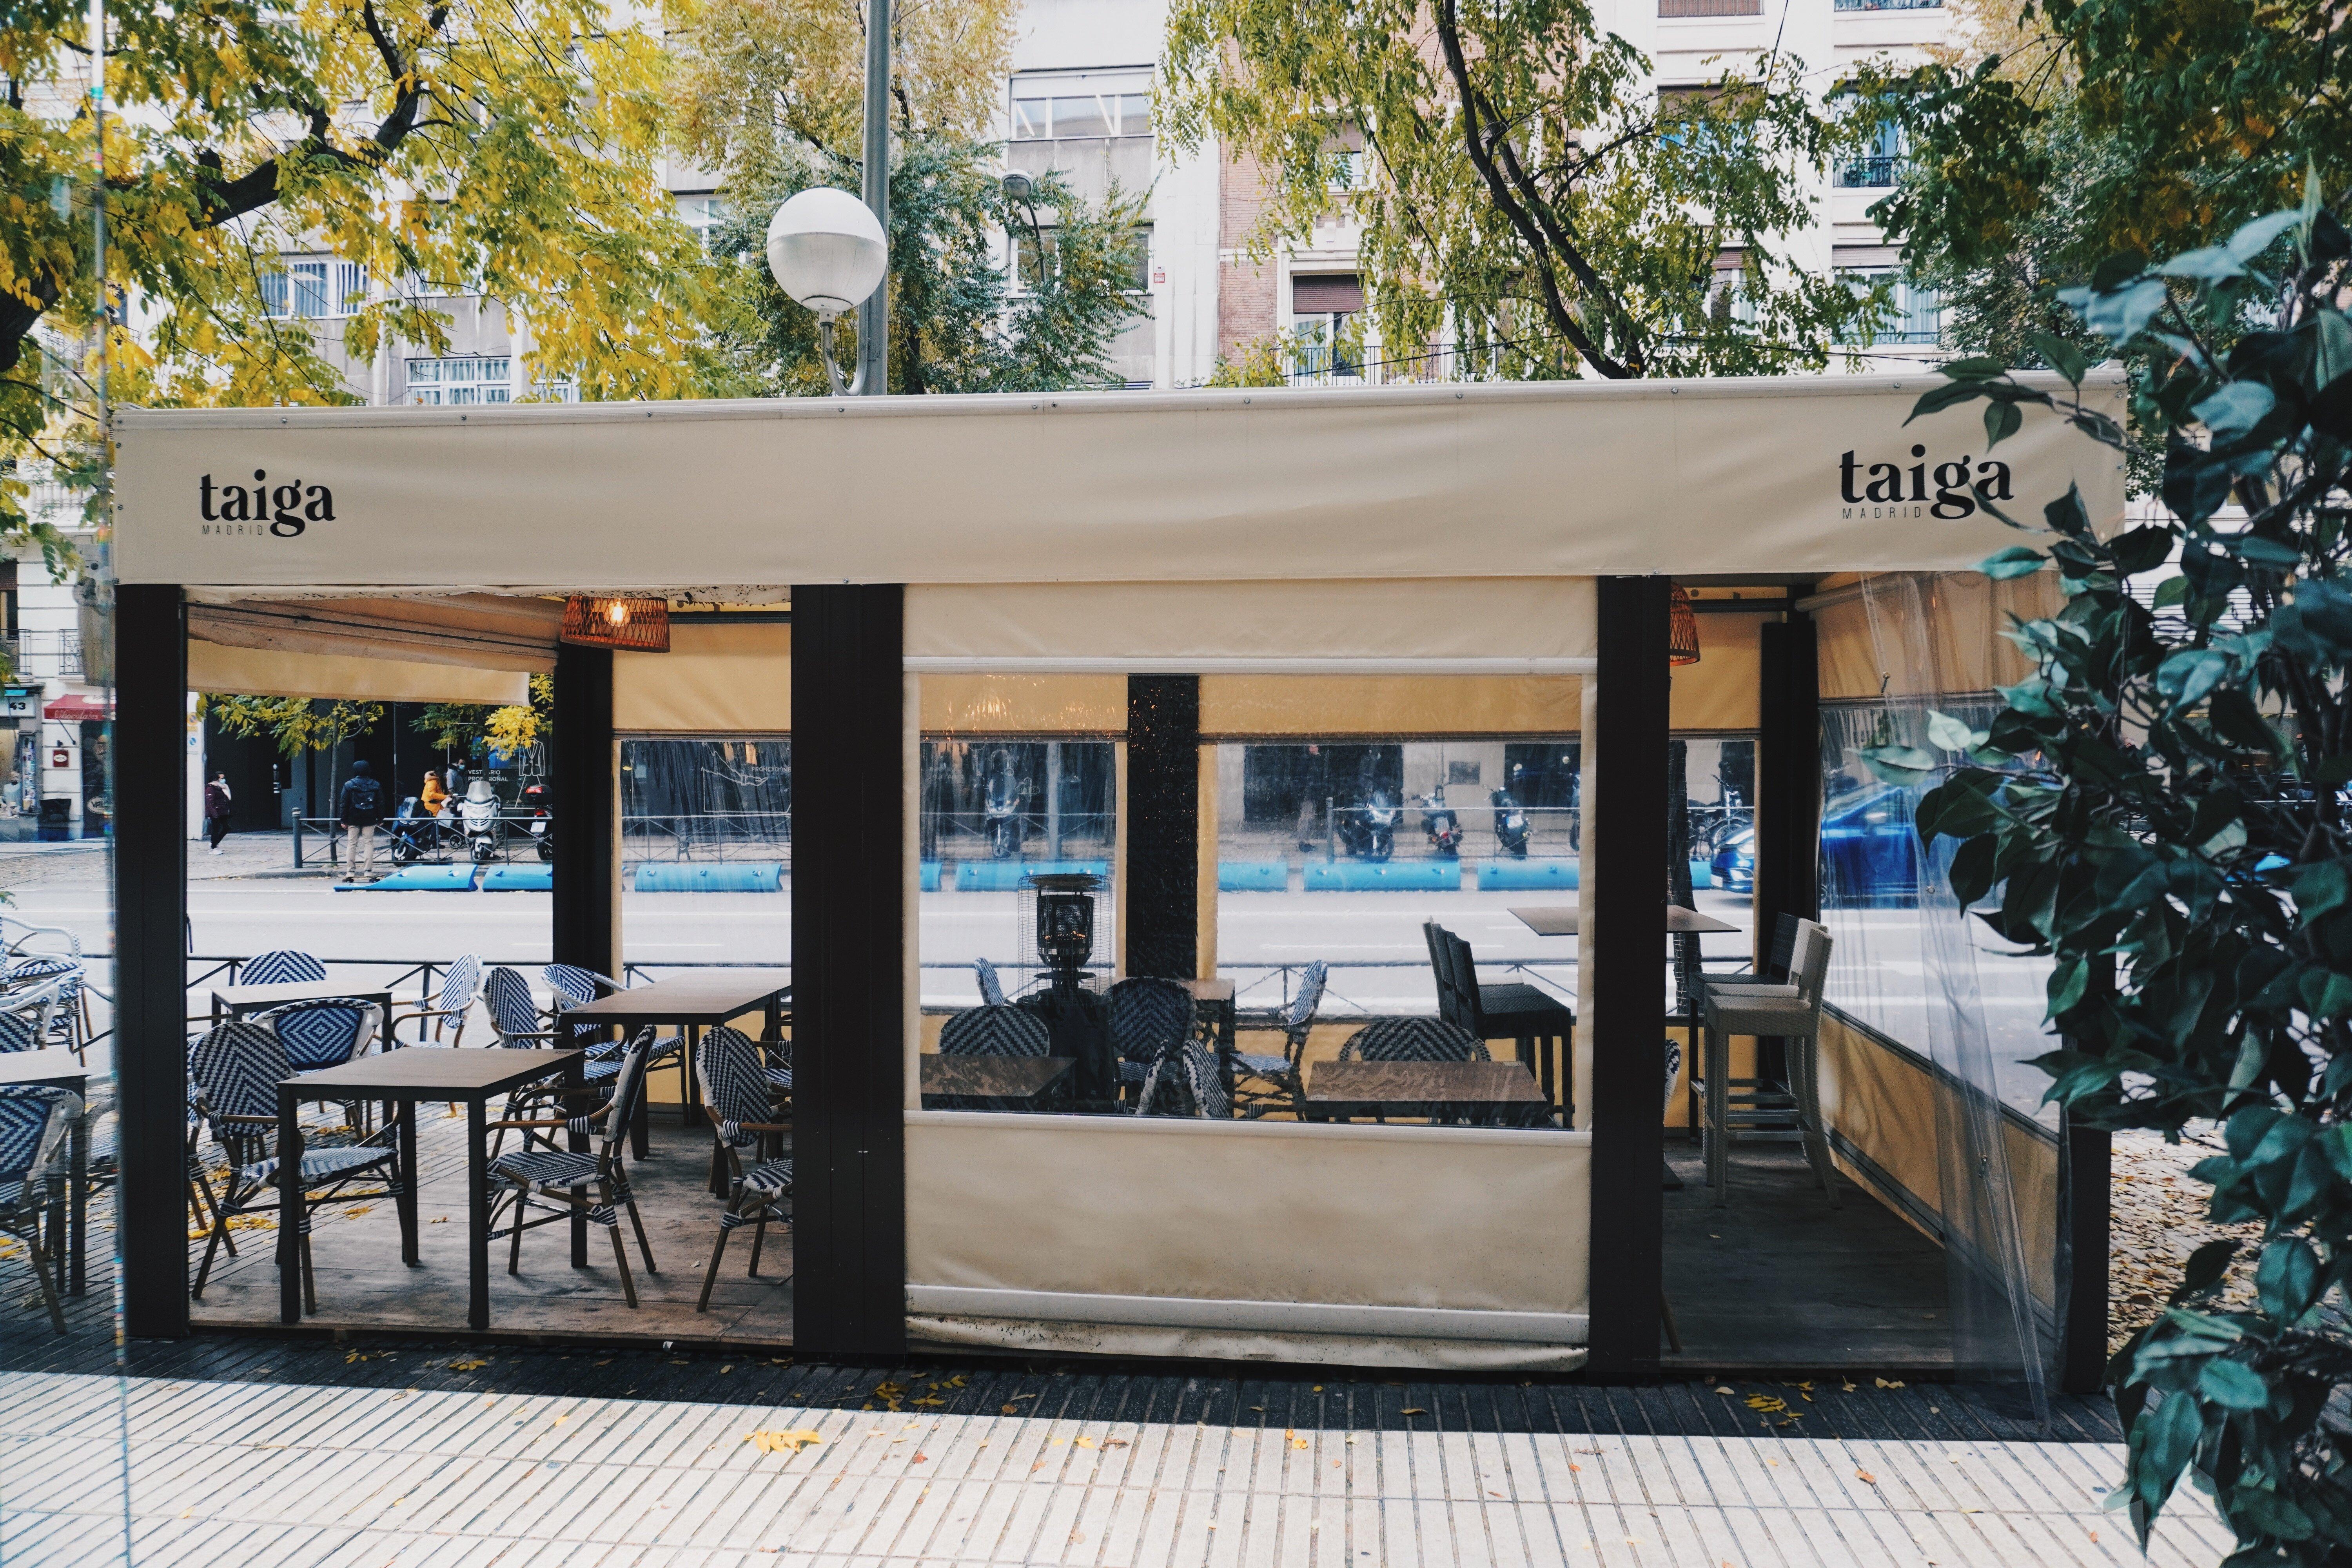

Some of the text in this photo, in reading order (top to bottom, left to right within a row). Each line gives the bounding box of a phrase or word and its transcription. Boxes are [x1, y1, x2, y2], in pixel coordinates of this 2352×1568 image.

[1839, 444, 2014, 519] taiga
[200, 469, 336, 537] taiga
[1843, 507, 1920, 519] MADRID
[202, 525, 263, 535] MADRID
